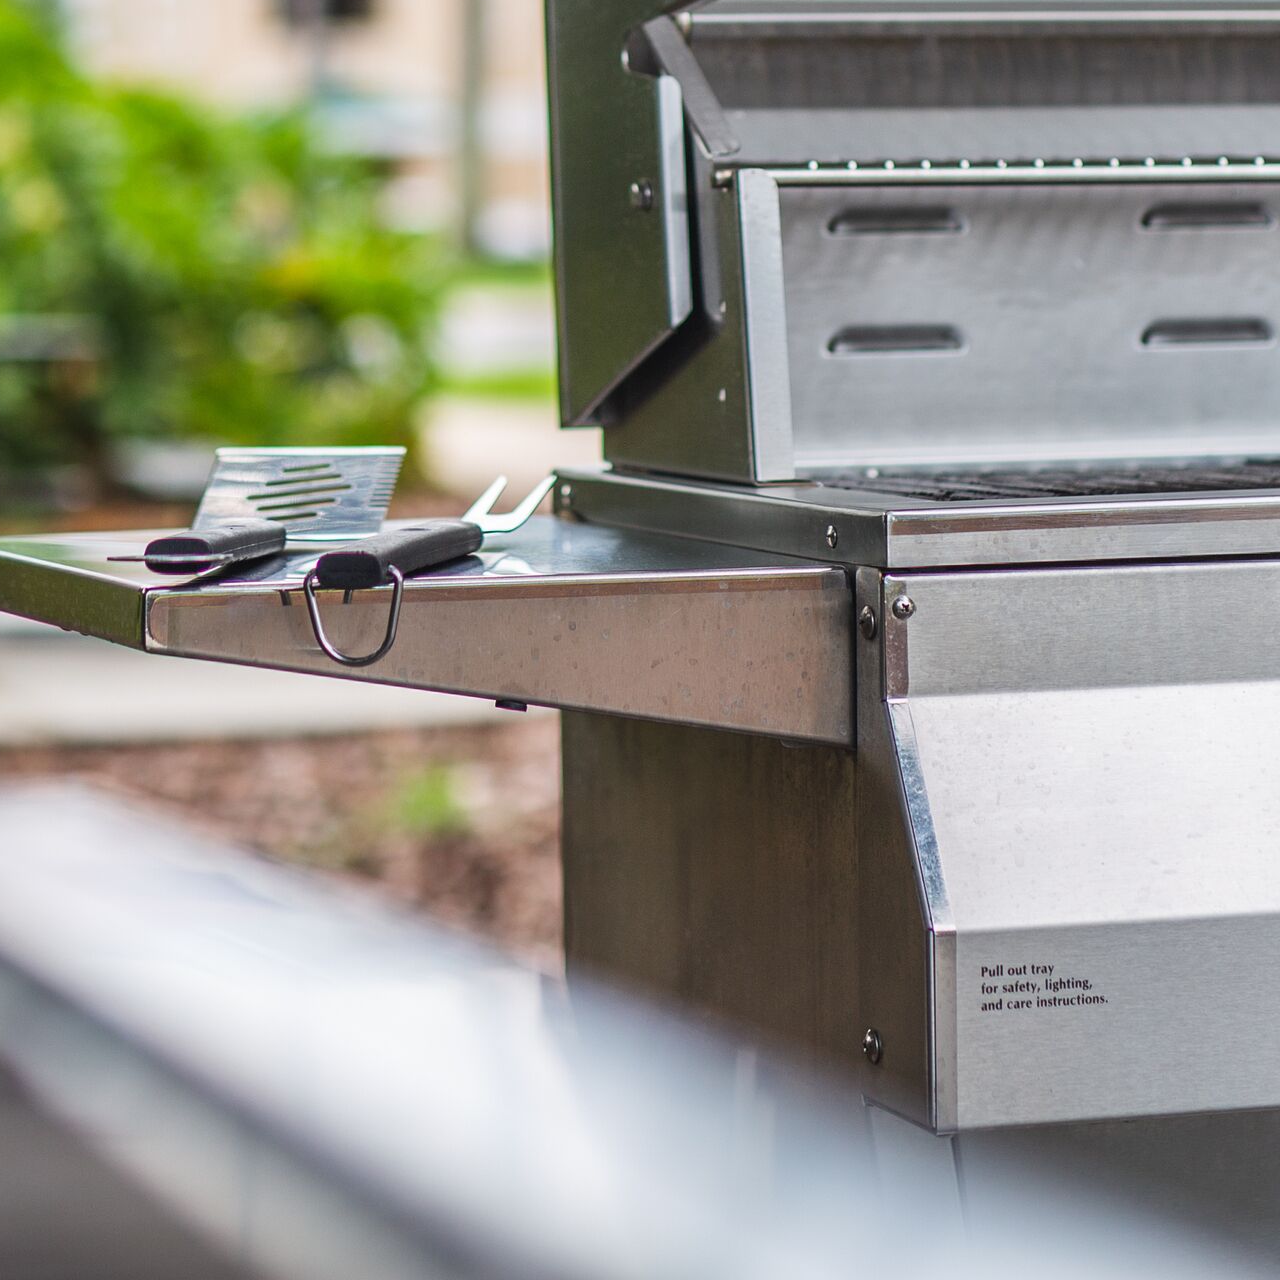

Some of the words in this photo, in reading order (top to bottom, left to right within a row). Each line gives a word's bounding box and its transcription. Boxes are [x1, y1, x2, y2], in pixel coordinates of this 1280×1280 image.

[981, 965, 1004, 978] Pull
[1007, 964, 1027, 976] out
[1031, 964, 1055, 976] tray
[981, 982, 999, 995] for
[1002, 981, 1041, 994] safety,
[1045, 978, 1093, 992] lighting,
[981, 998, 1003, 1012] and
[1007, 1000, 1033, 1010] care
[1036, 994, 1109, 1008] instructions.
